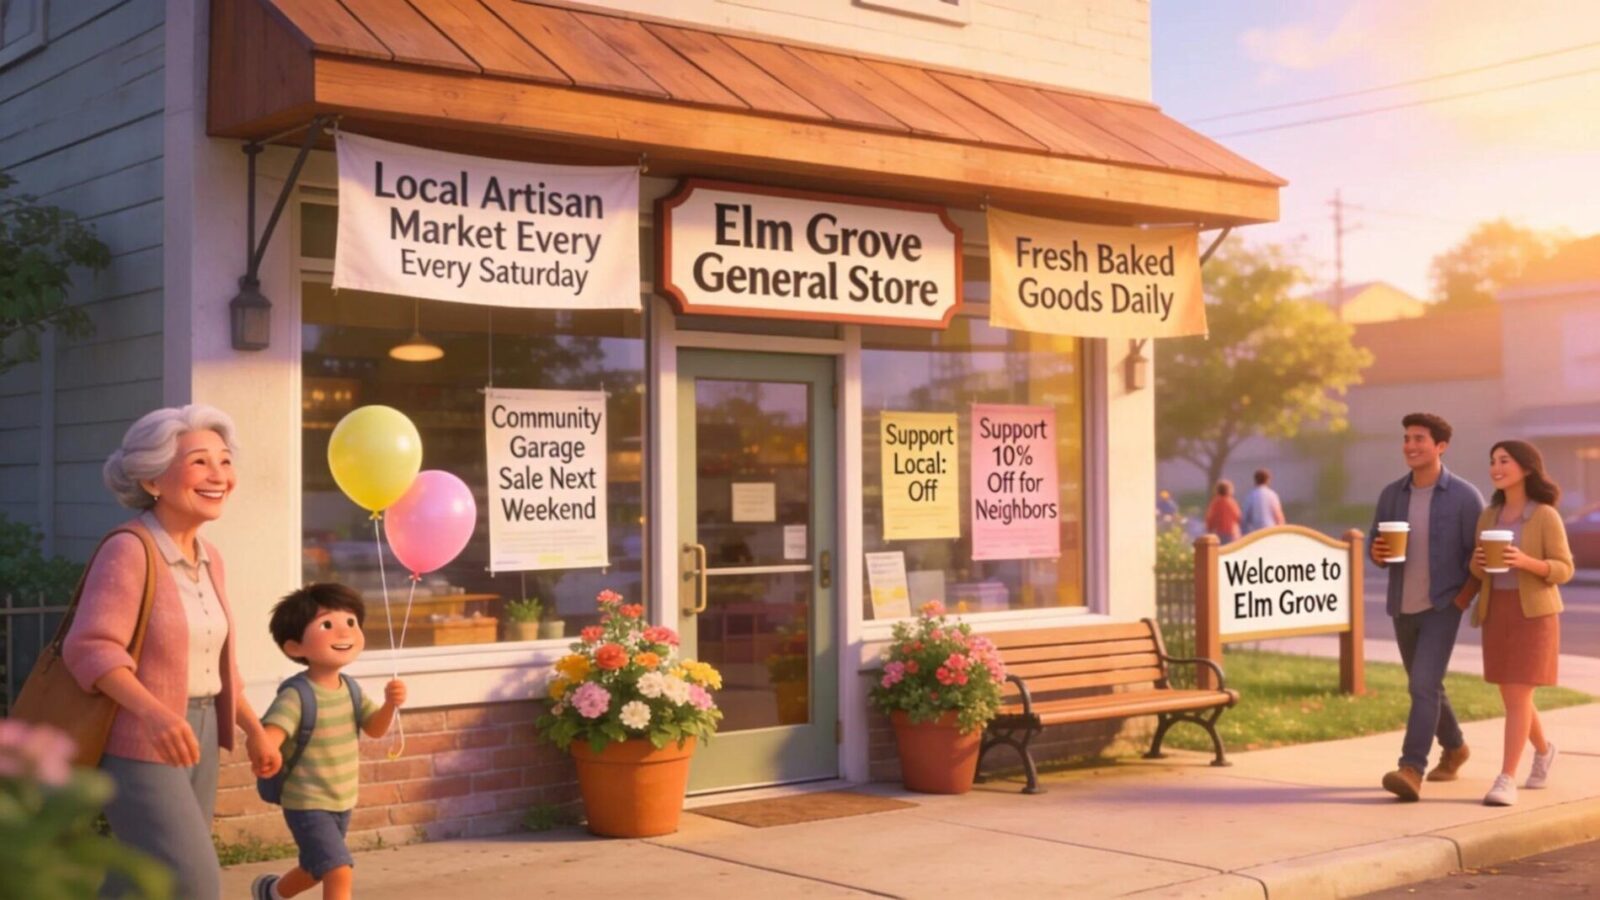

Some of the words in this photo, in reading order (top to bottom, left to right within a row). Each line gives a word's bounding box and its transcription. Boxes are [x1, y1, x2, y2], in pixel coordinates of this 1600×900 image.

[374, 160, 469, 208] Local
[480, 175, 603, 219] Artisan
[390, 206, 507, 249] Market
[517, 220, 602, 263] Every
[713, 202, 793, 252] Elm
[805, 211, 923, 262] Grove
[1015, 235, 1088, 273] Fresh
[1096, 242, 1175, 276] Baked
[400, 248, 472, 289] Every
[479, 256, 589, 296] Saturday
[692, 252, 839, 301] General
[848, 264, 938, 307] Store
[1018, 276, 1103, 313] Goods
[1110, 282, 1174, 322] Daily
[491, 404, 602, 436] Community
[979, 416, 1047, 444] Support
[509, 435, 586, 465] Garage
[885, 422, 954, 452] Support
[894, 450, 947, 475] Local:
[992, 444, 1033, 467] 10%
[499, 465, 543, 490] Sale
[549, 466, 597, 490] Next
[908, 478, 938, 502] Off
[987, 470, 1016, 494] Off
[1018, 470, 1044, 493] for
[500, 495, 596, 522] Weekend
[975, 497, 1058, 526] Neighbors
[1224, 557, 1316, 587] Welcome
[1321, 557, 1341, 581] to
[1234, 590, 1273, 620] Elm
[1278, 589, 1338, 615] Grove
